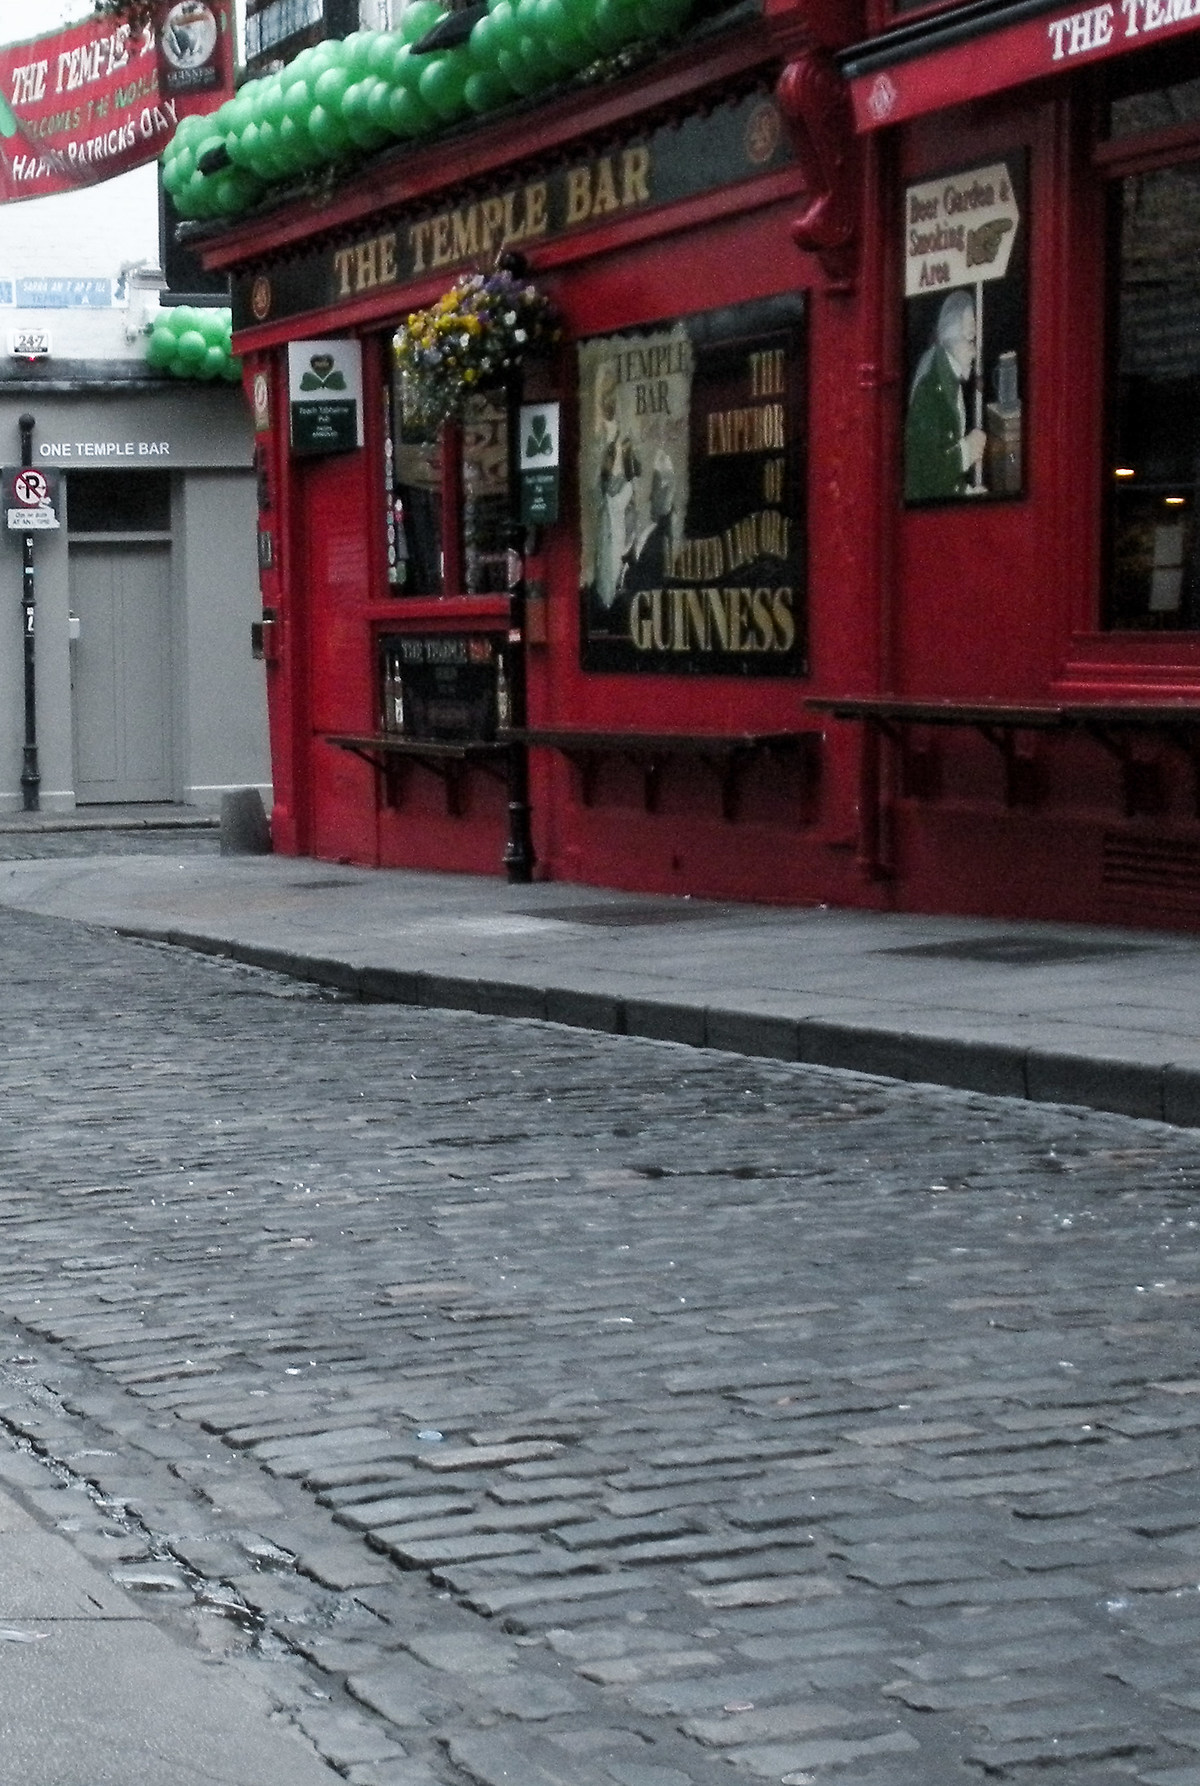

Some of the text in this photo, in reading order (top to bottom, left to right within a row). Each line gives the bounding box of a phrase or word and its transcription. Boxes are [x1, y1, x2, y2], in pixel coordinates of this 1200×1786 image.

[1049, 0, 1200, 60] THE TEM
[11, 59, 48, 105] THE
[55, 24, 131, 93] TEMPLE
[139, 98, 179, 138] DAY
[335, 148, 650, 295] THE TEMPLE BAR
[919, 260, 951, 287] Area
[616, 340, 691, 383] TEMPLE
[635, 379, 671, 415] BAR
[39, 441, 171, 457] ONE TEMPLE BAR
[629, 588, 795, 652] GUINNESS
